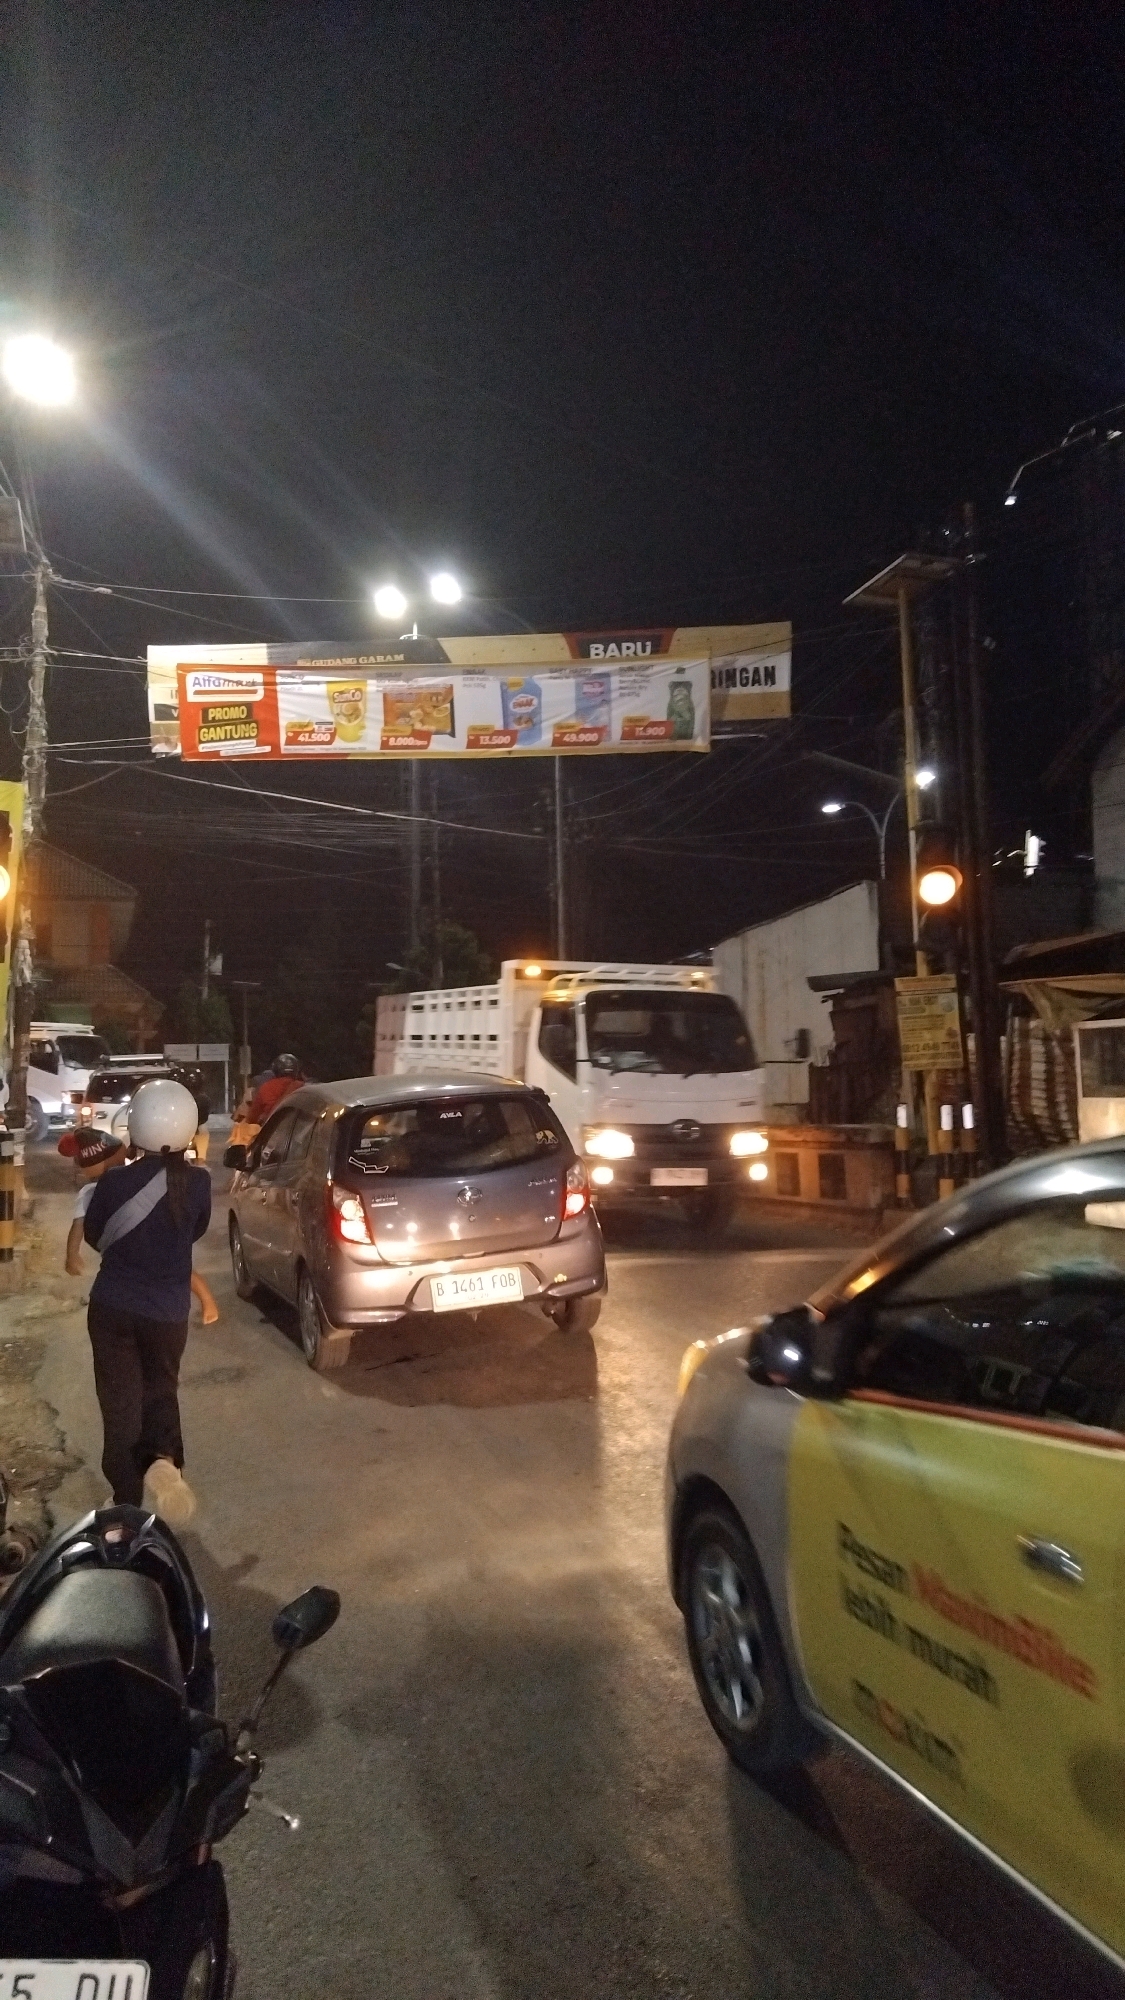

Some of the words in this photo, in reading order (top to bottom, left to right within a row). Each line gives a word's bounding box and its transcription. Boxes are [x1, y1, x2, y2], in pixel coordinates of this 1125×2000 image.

[589, 641, 652, 658] BARU
[311, 657, 357, 666] GUDANG
[358, 653, 405, 665] GARAM
[208, 705, 248, 721] PROMO
[199, 723, 258, 742] GANTUNG
[297, 733, 331, 742] 41.500
[479, 735, 511, 745] 13.500
[562, 733, 599, 742] 49.900
[435, 1282, 445, 1296] B
[451, 1276, 484, 1295] 1461
[491, 1272, 516, 1289] FOB
[0, 1973, 37, 2000] 5
